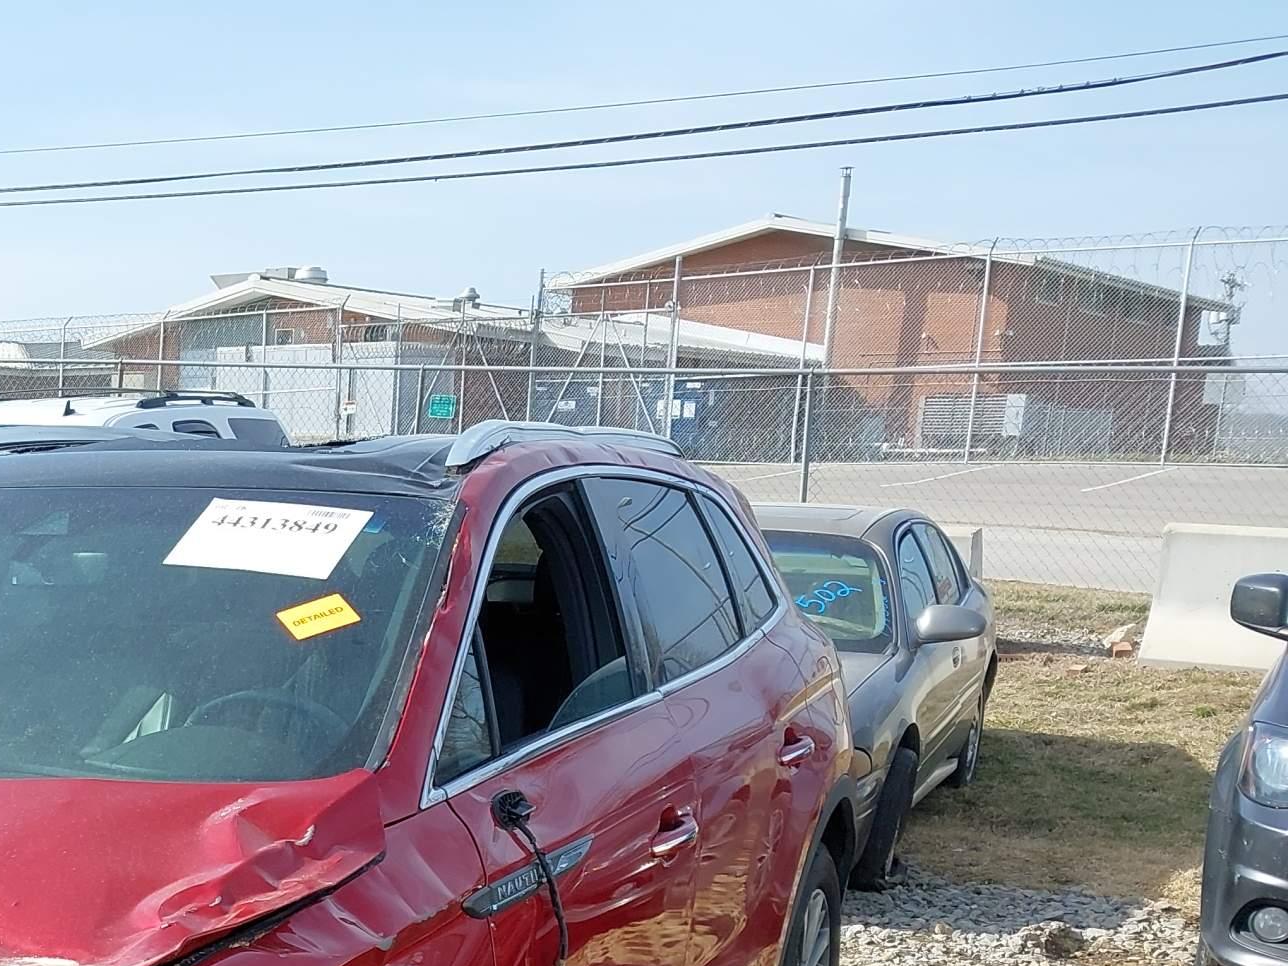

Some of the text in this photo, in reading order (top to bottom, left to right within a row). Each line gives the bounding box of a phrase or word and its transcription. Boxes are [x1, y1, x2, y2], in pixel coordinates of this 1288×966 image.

[211, 514, 340, 536] 44313849
[795, 580, 863, 613] 502
[292, 606, 344, 627] DETAILED
